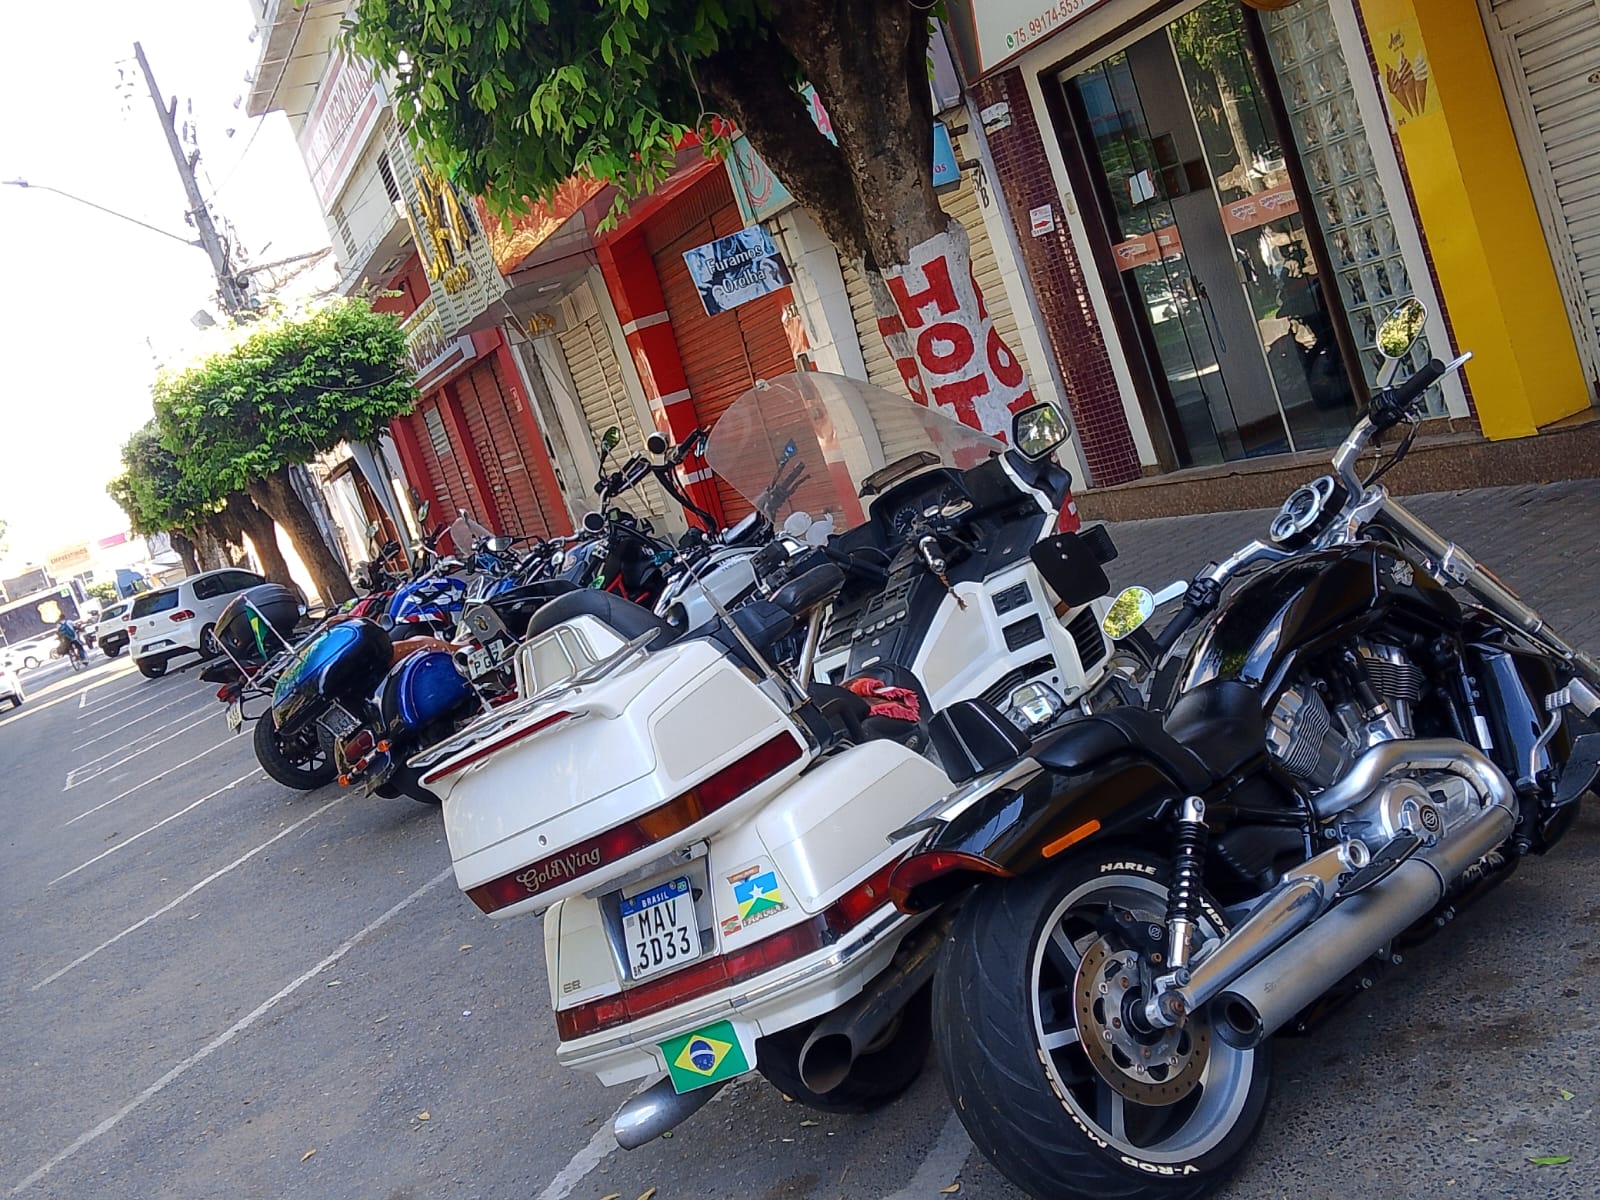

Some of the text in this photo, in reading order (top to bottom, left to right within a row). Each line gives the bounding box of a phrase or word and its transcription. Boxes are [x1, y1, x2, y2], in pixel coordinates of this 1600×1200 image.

[705, 244, 764, 275] Furamos
[722, 268, 767, 294] Orelha
[1100, 861, 1158, 876] HARLE
[641, 890, 671, 908] BRASIL
[637, 899, 677, 940] MAV
[636, 926, 691, 970] 3D33
[1120, 1156, 1201, 1176] V-ROD
